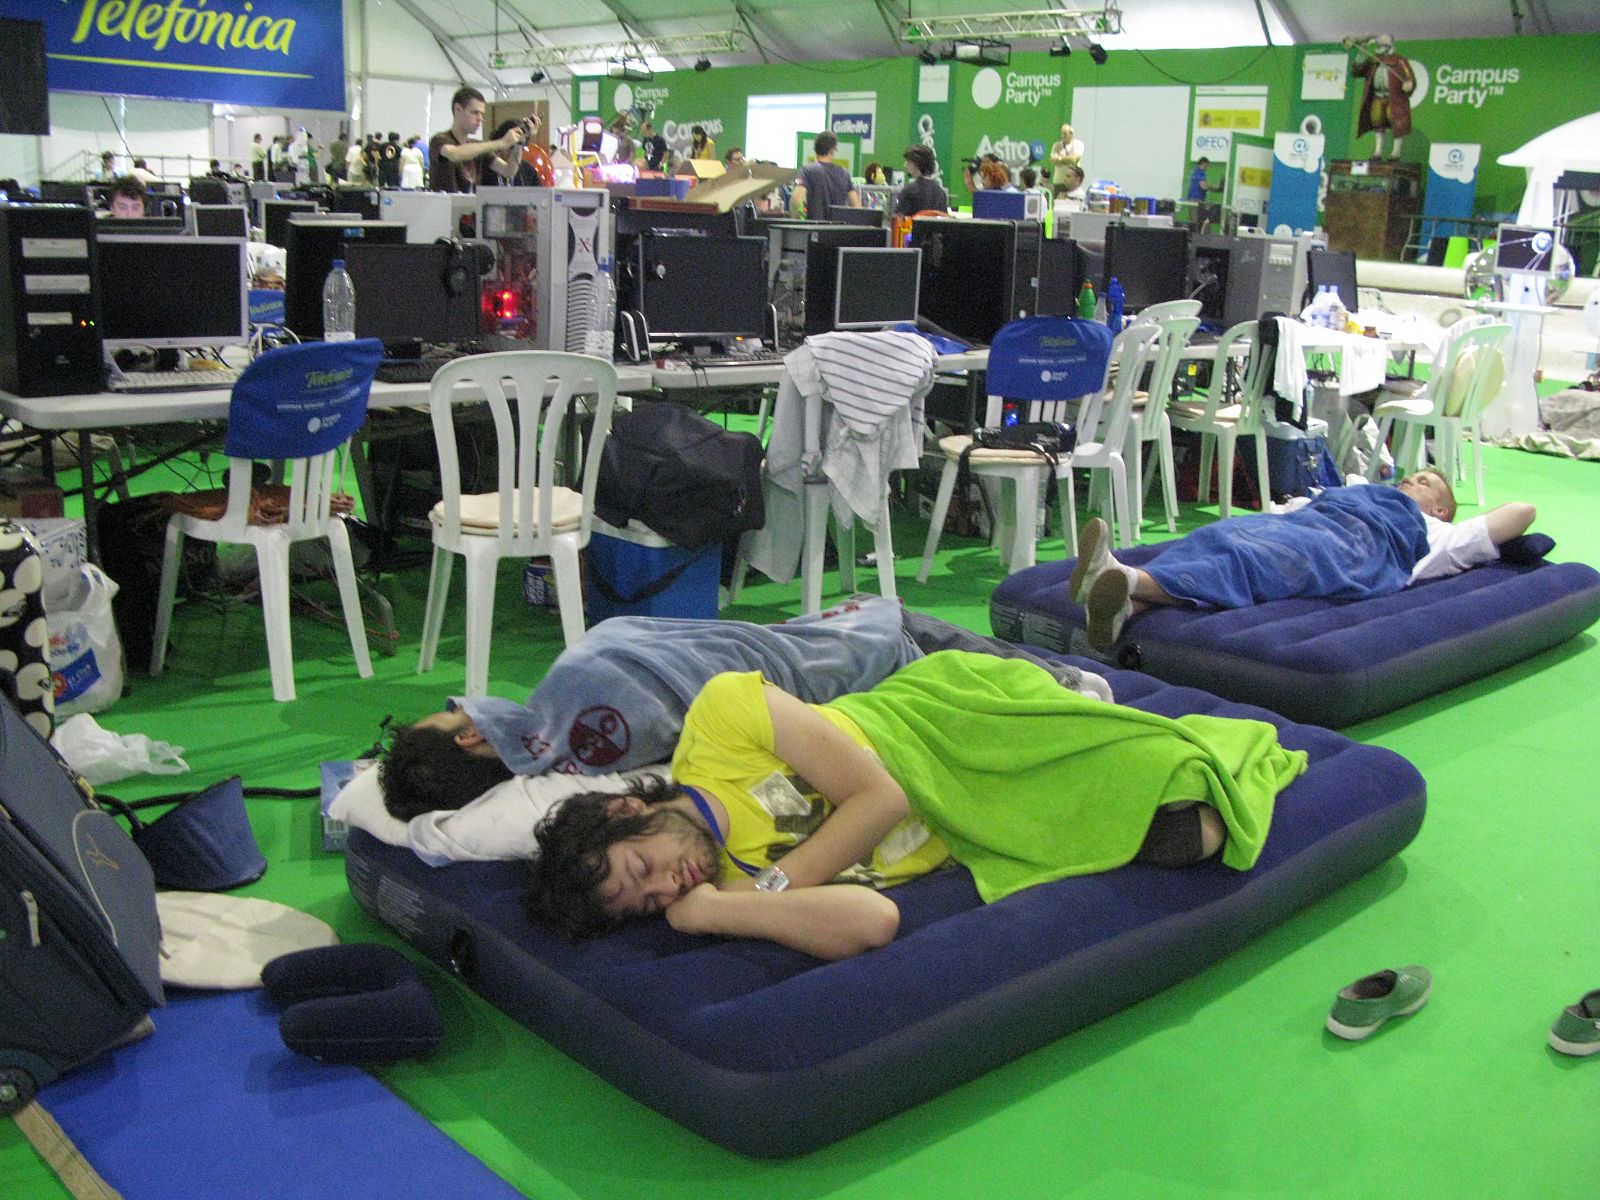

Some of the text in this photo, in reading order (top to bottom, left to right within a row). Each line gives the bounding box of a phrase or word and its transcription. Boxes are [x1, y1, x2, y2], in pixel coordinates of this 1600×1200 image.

[1006, 73, 1061, 90] Campus
[1435, 65, 1520, 87] Campus
[975, 134, 1031, 161] Astro
